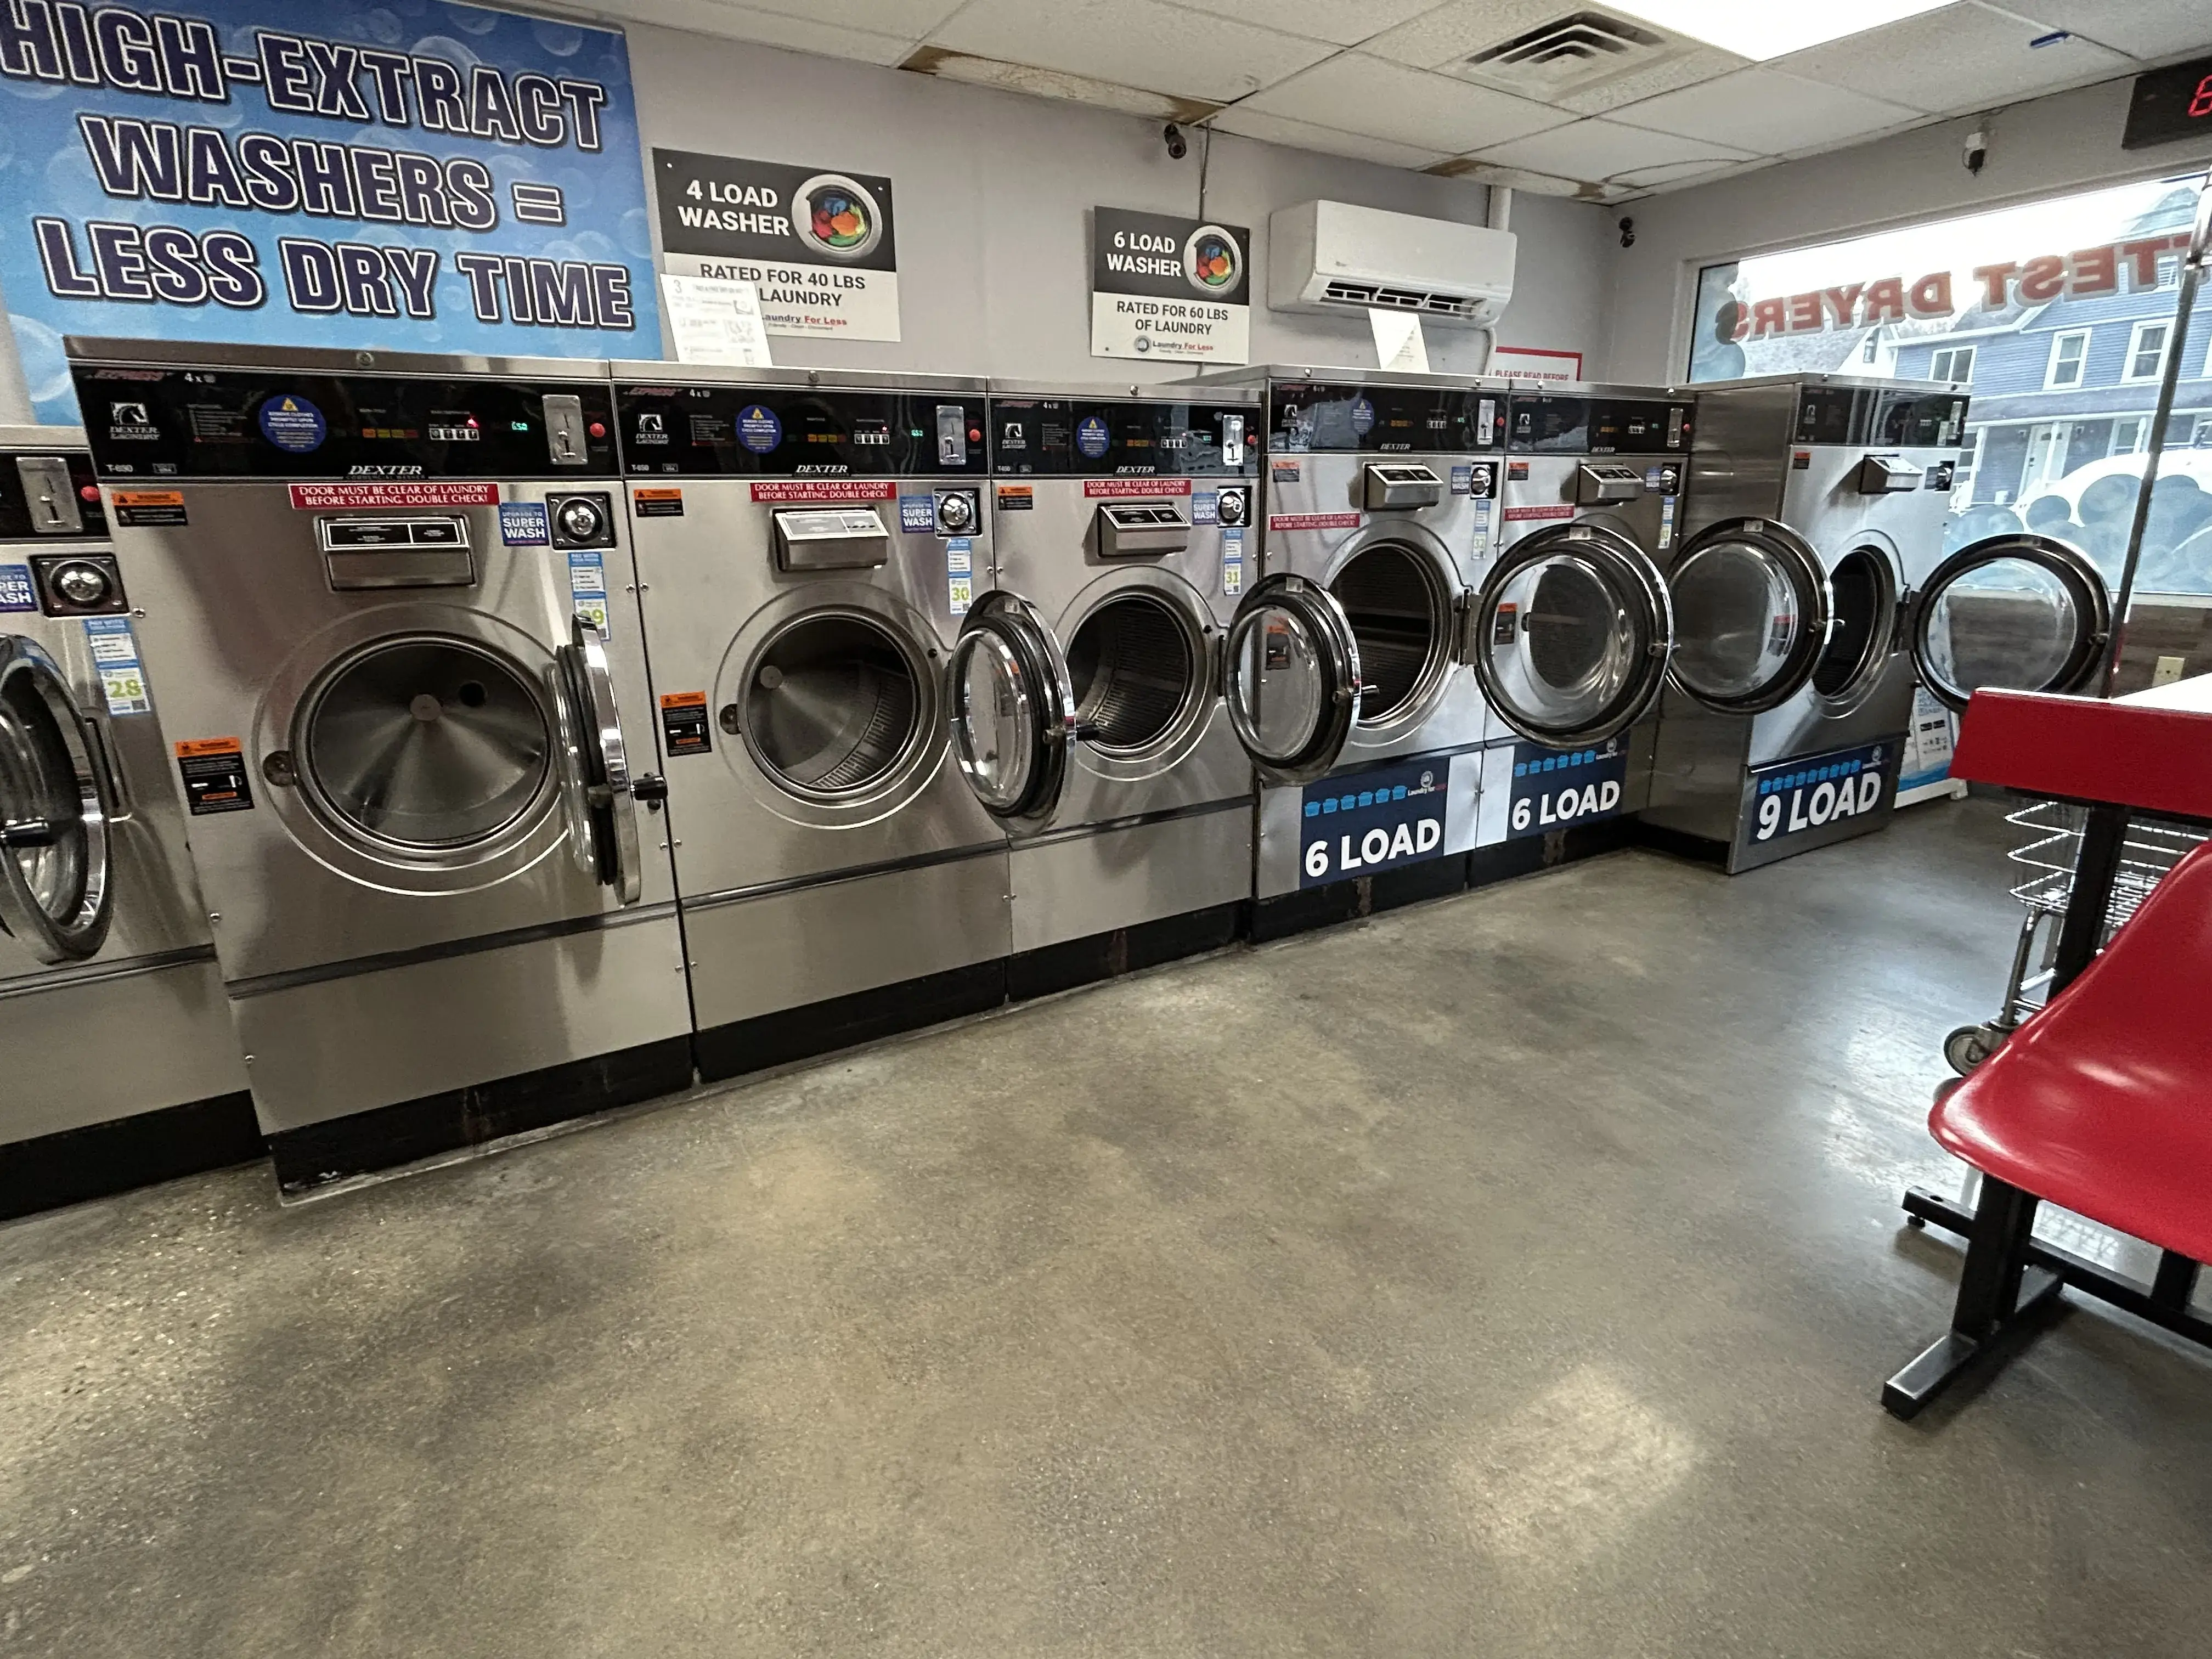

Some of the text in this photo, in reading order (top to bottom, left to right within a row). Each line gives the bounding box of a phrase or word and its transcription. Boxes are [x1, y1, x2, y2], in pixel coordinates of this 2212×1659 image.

[0, 0, 605, 149] HIGH-EXTRACT
[79, 115, 497, 230] WASHERS
[686, 179, 777, 207] 4 LOAD
[678, 206, 790, 236] WASHER
[1114, 231, 1175, 253] 6 LOAD
[36, 218, 264, 306] LESS
[280, 239, 437, 317] DRY
[458, 253, 633, 328] TIME
[1107, 253, 1181, 276] WASHER
[700, 263, 865, 289] RATED FOR 40 LBS
[760, 288, 842, 306] LAUNDRY
[1117, 301, 1228, 320] RATED FOR 60 LBS
[824, 317, 847, 325] Less
[1135, 319, 1211, 335] OF LAUNDRY
[1153, 341, 1182, 349] Laundry
[348, 465, 421, 475] DEXTER
[796, 465, 848, 473] DEXTER
[300, 487, 334, 495] DOOR
[387, 486, 421, 494] CLEAR
[424, 486, 438, 494] OF
[306, 496, 346, 505] BEFORE
[407, 495, 448, 504] DOUBLE
[902, 509, 932, 517] SUPER
[904, 517, 933, 526] WASH
[1194, 511, 1216, 519] WASH
[503, 518, 544, 527] SUPER
[505, 528, 545, 538] WASH
[1226, 571, 1239, 584] 31
[952, 587, 969, 601] 30
[108, 679, 142, 698] 28
[1512, 780, 1620, 831] 6 LOAD
[1757, 771, 1881, 840] 9 LOAD
[1306, 819, 1440, 877] 6 LOAD
